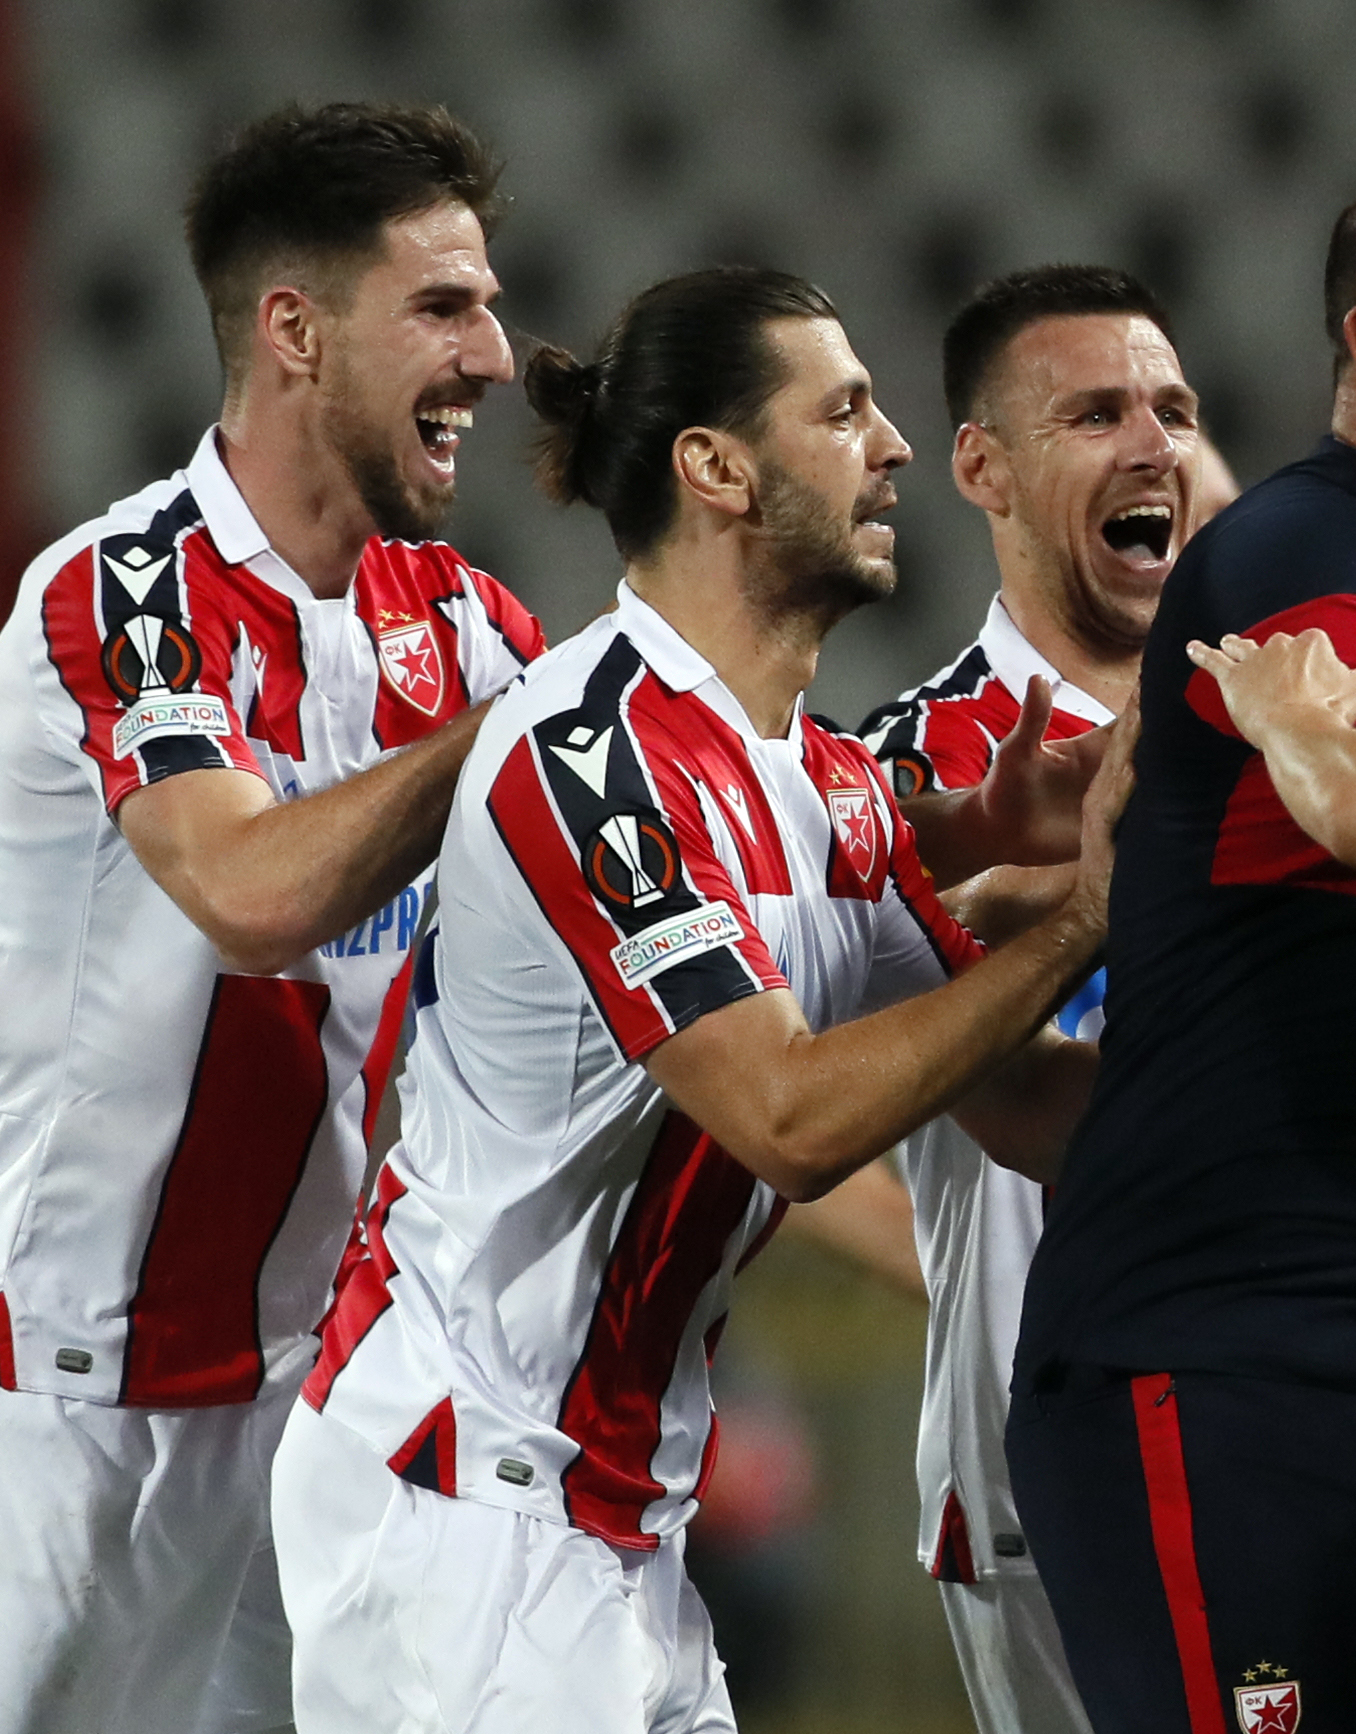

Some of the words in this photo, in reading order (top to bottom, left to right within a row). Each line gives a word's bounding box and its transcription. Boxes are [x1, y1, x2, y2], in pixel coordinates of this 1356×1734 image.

[116, 707, 225, 748] FOUNDATION
[614, 940, 640, 960] UEFA
[619, 913, 734, 975] FOUNDATION
